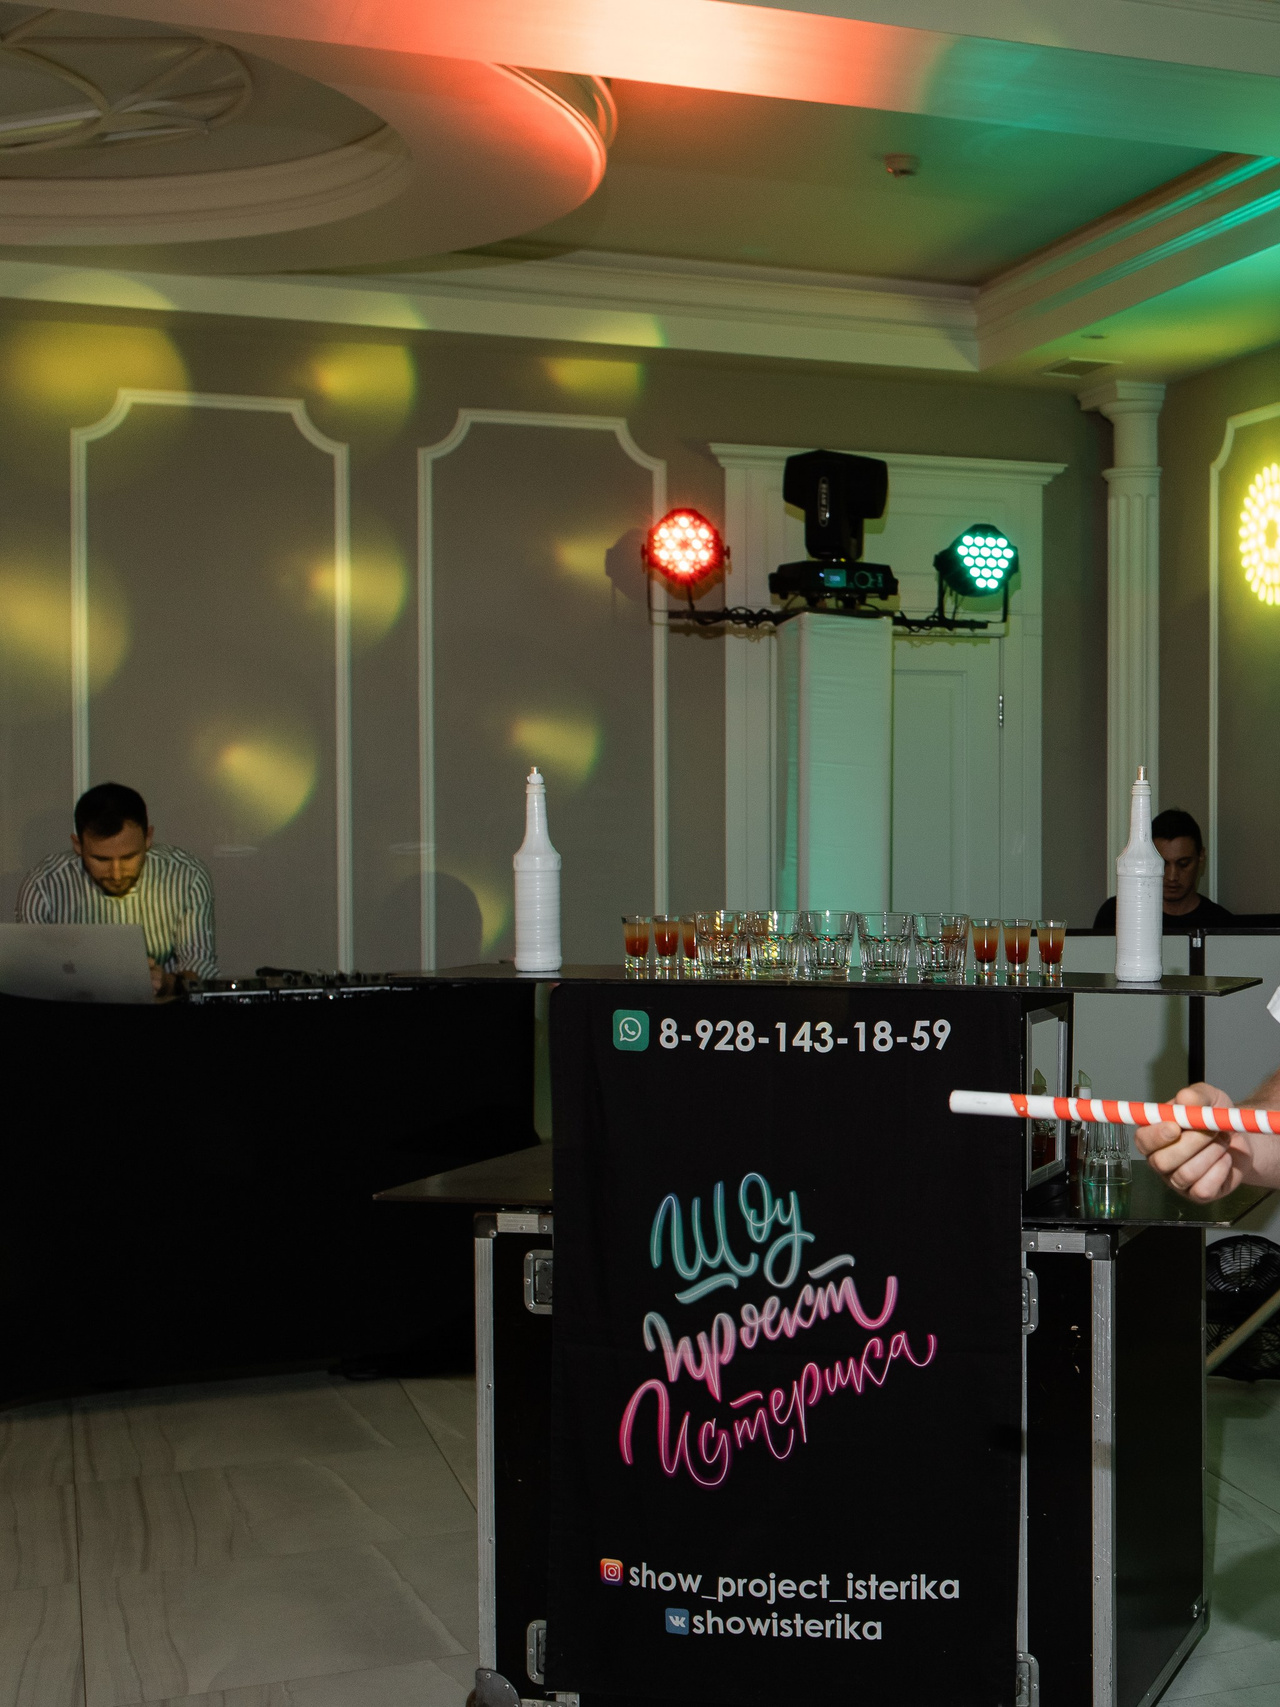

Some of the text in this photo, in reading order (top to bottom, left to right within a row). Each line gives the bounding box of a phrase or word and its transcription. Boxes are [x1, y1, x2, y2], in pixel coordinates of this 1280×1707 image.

[658, 1017, 952, 1054] 8-928-143-18-59
[618, 1331, 938, 1486] Истерика
[628, 1561, 960, 1605] show_project_isterika
[692, 1609, 883, 1641] showisterika
